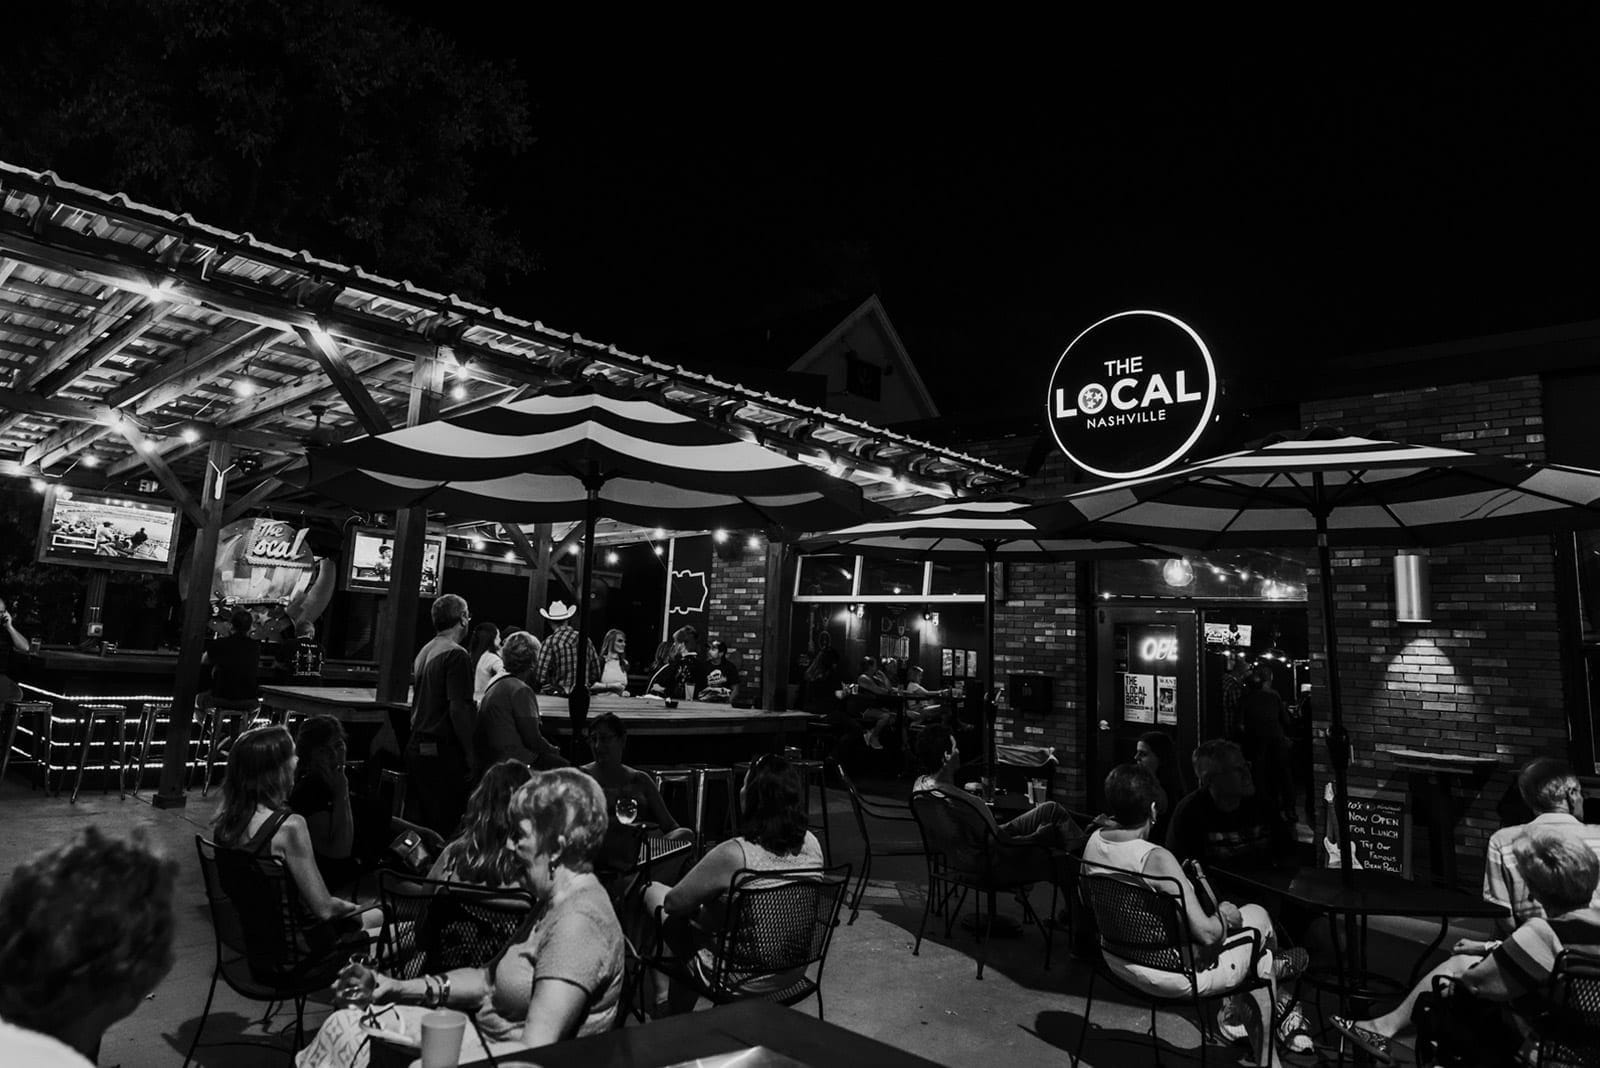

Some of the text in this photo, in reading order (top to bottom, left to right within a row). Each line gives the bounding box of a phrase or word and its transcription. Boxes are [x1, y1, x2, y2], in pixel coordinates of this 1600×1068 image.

[1104, 356, 1143, 376] THE
[1056, 370, 1202, 418] LOCAL
[1087, 409, 1167, 429] NASHVILLE
[258, 520, 290, 537] The
[1142, 638, 1177, 660] OPE
[1126, 675, 1137, 685] THE
[1126, 685, 1147, 696] LOCAL
[1126, 695, 1144, 705] BREW
[1348, 811, 1399, 826] NOW OPEN
[1349, 824, 1399, 839] FOR LUNCH
